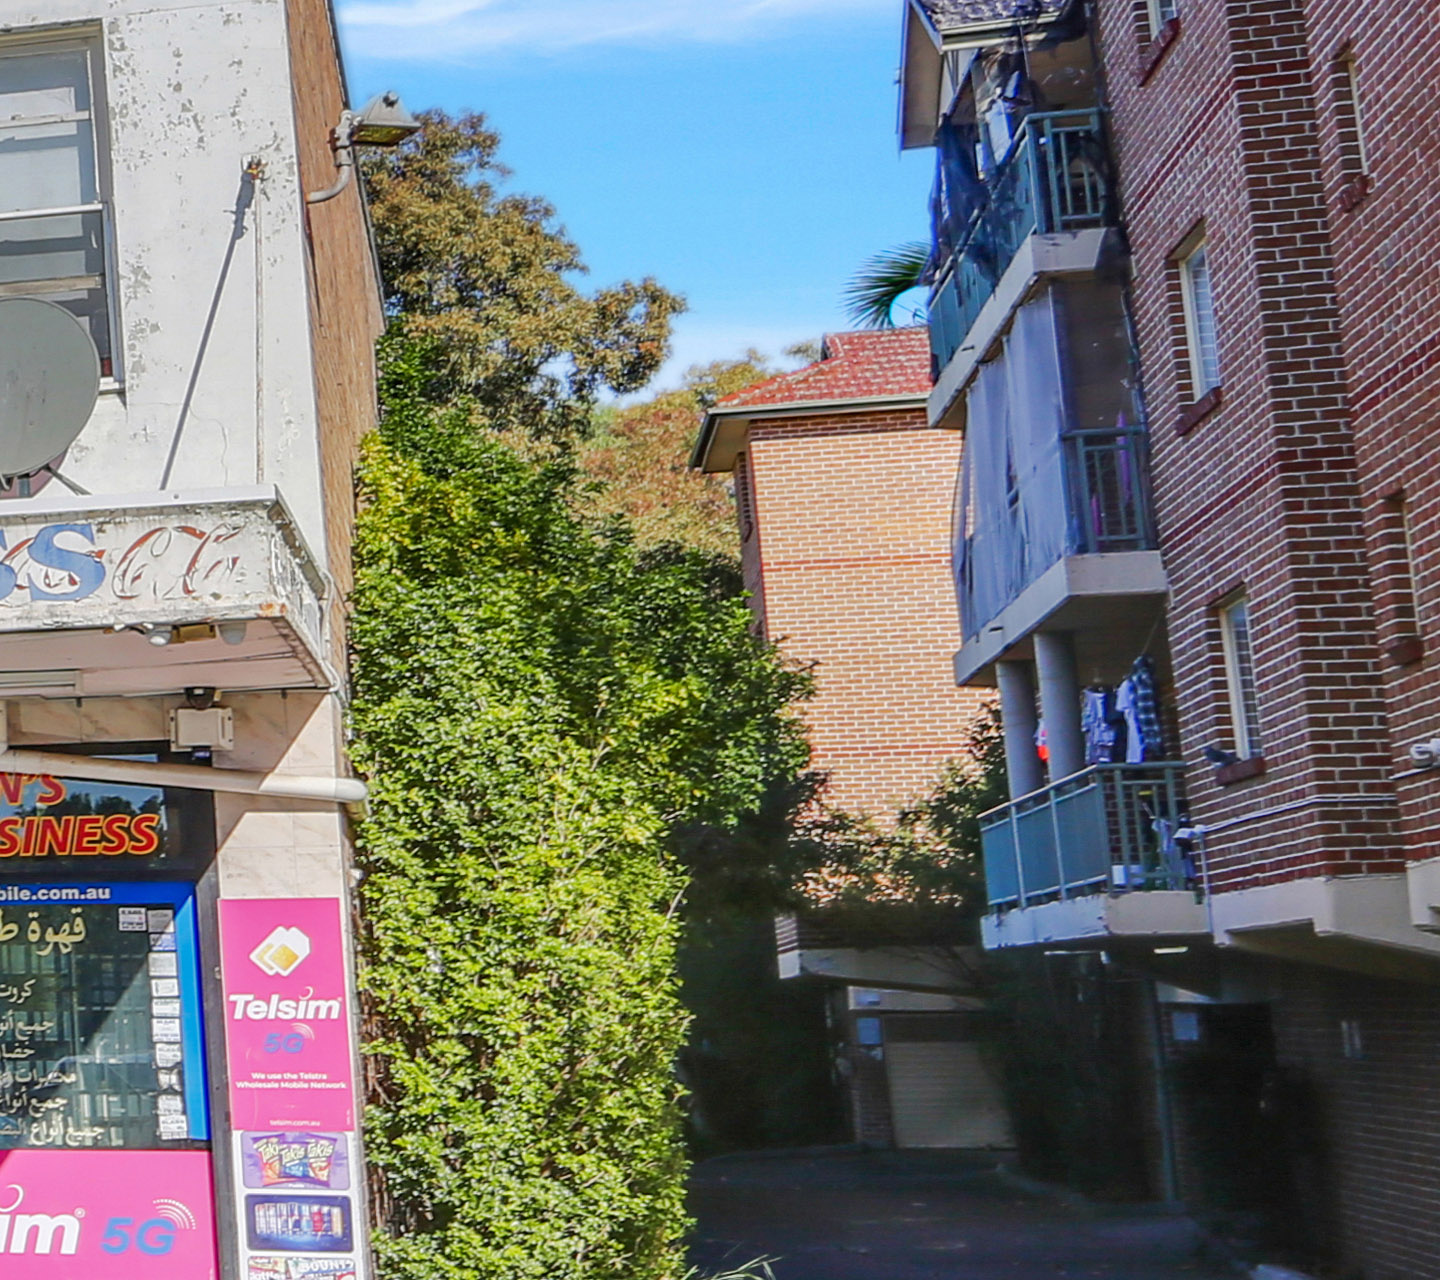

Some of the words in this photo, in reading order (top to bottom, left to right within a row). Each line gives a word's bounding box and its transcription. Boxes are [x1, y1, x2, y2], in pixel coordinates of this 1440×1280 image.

[27, 907, 87, 956] قهوة
[229, 986, 340, 1020] Telsim
[264, 1033, 303, 1053] 5G
[236, 1081, 279, 1089] Wholesale
[281, 1081, 309, 1089] Mobile
[310, 1081, 346, 1089] Network
[299, 1072, 327, 1080] Telstra
[260, 1143, 280, 1163] Taki
[100, 1217, 176, 1256] 5G
